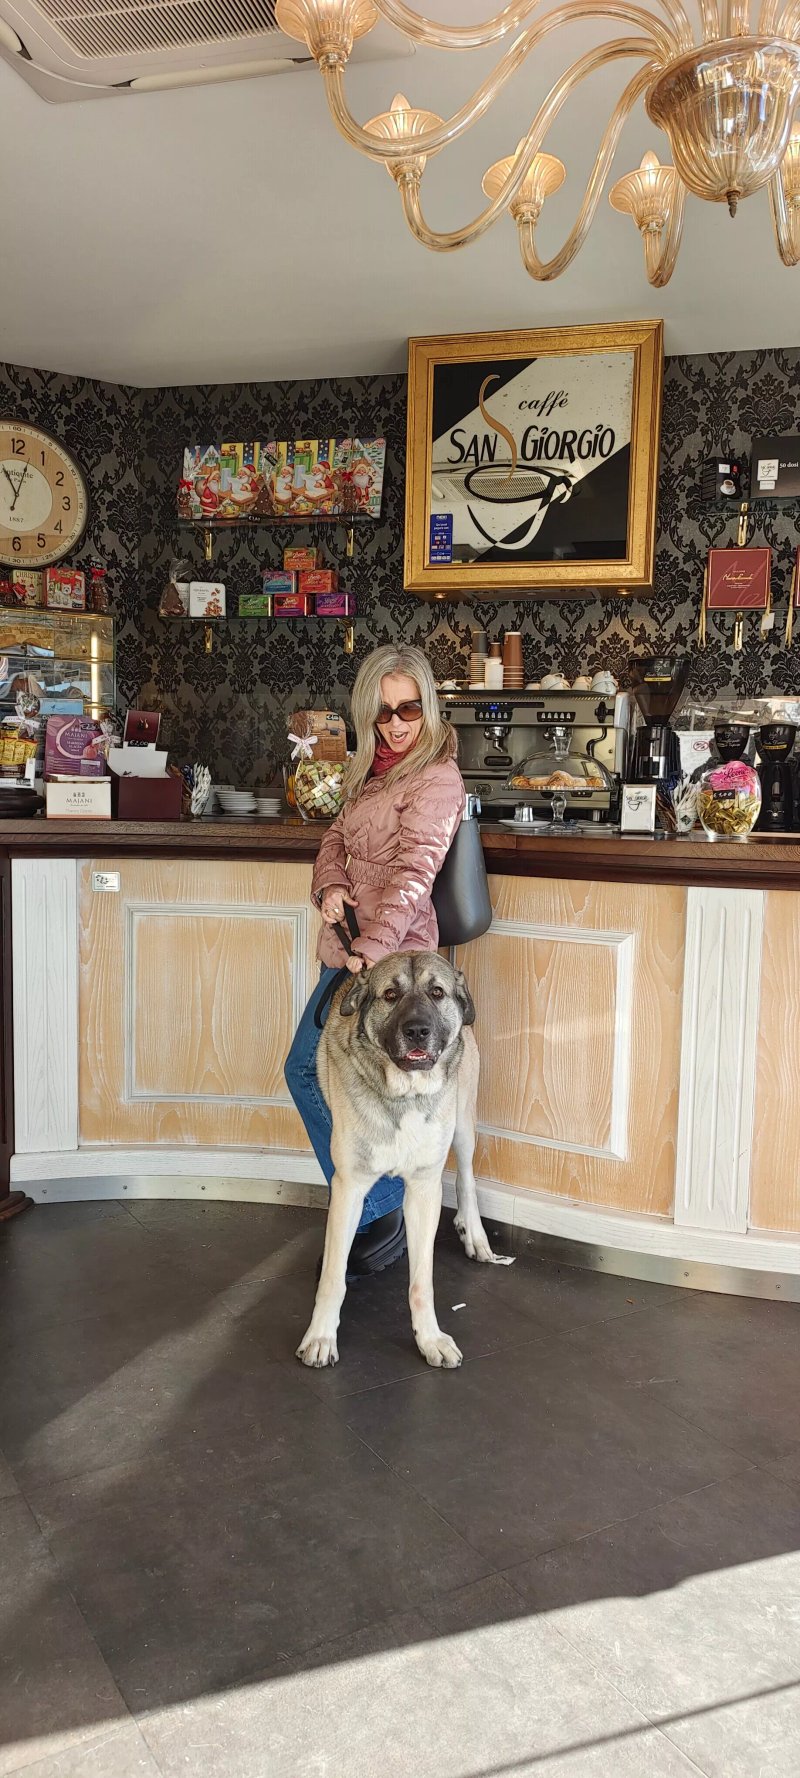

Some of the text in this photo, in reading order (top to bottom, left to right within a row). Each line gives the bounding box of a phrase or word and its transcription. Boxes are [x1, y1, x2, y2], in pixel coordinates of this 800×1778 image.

[518, 390, 570, 417] caffé
[11, 437, 26, 456] 12
[446, 424, 616, 467] SAN GIORGIO
[40, 450, 46, 467] 1
[55, 471, 65, 487] 2
[62, 495, 71, 511] 3
[53, 519, 63, 534] 4
[12, 536, 22, 552] 6
[36, 532, 46, 549] 5
